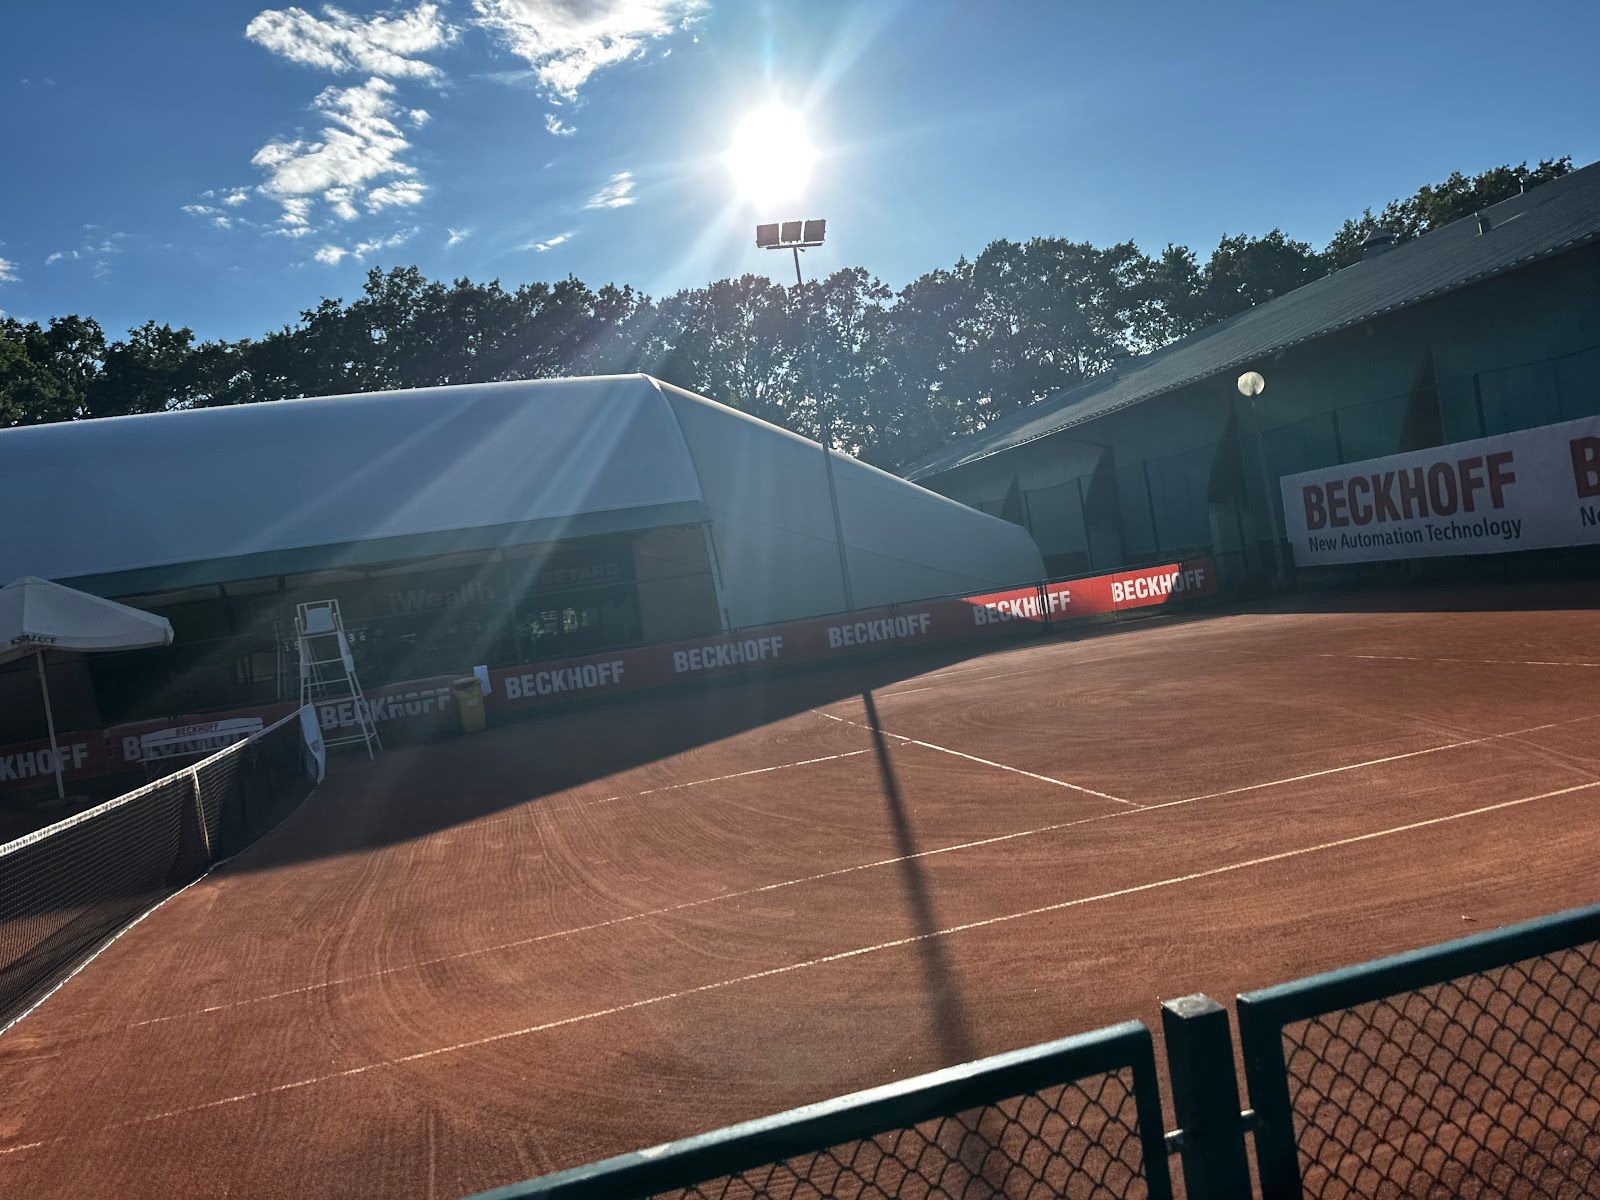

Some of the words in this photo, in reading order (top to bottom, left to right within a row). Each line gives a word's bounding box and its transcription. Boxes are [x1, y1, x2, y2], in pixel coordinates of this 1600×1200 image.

[1302, 451, 1516, 531] BECKHOFF
[1580, 506, 1600, 527] N
[1309, 537, 1337, 552] New
[1341, 527, 1423, 549] Automation
[1426, 517, 1522, 540] Technology
[1111, 568, 1205, 603] BECKHOFF
[973, 591, 1071, 625] BECKHOFF
[828, 613, 931, 648] BECKHOFF
[673, 636, 784, 673] BECKHOFF
[505, 660, 625, 699] BECKHOFF
[320, 687, 450, 730] BECKHOFF
[176, 722, 219, 736] BECKHOFF
